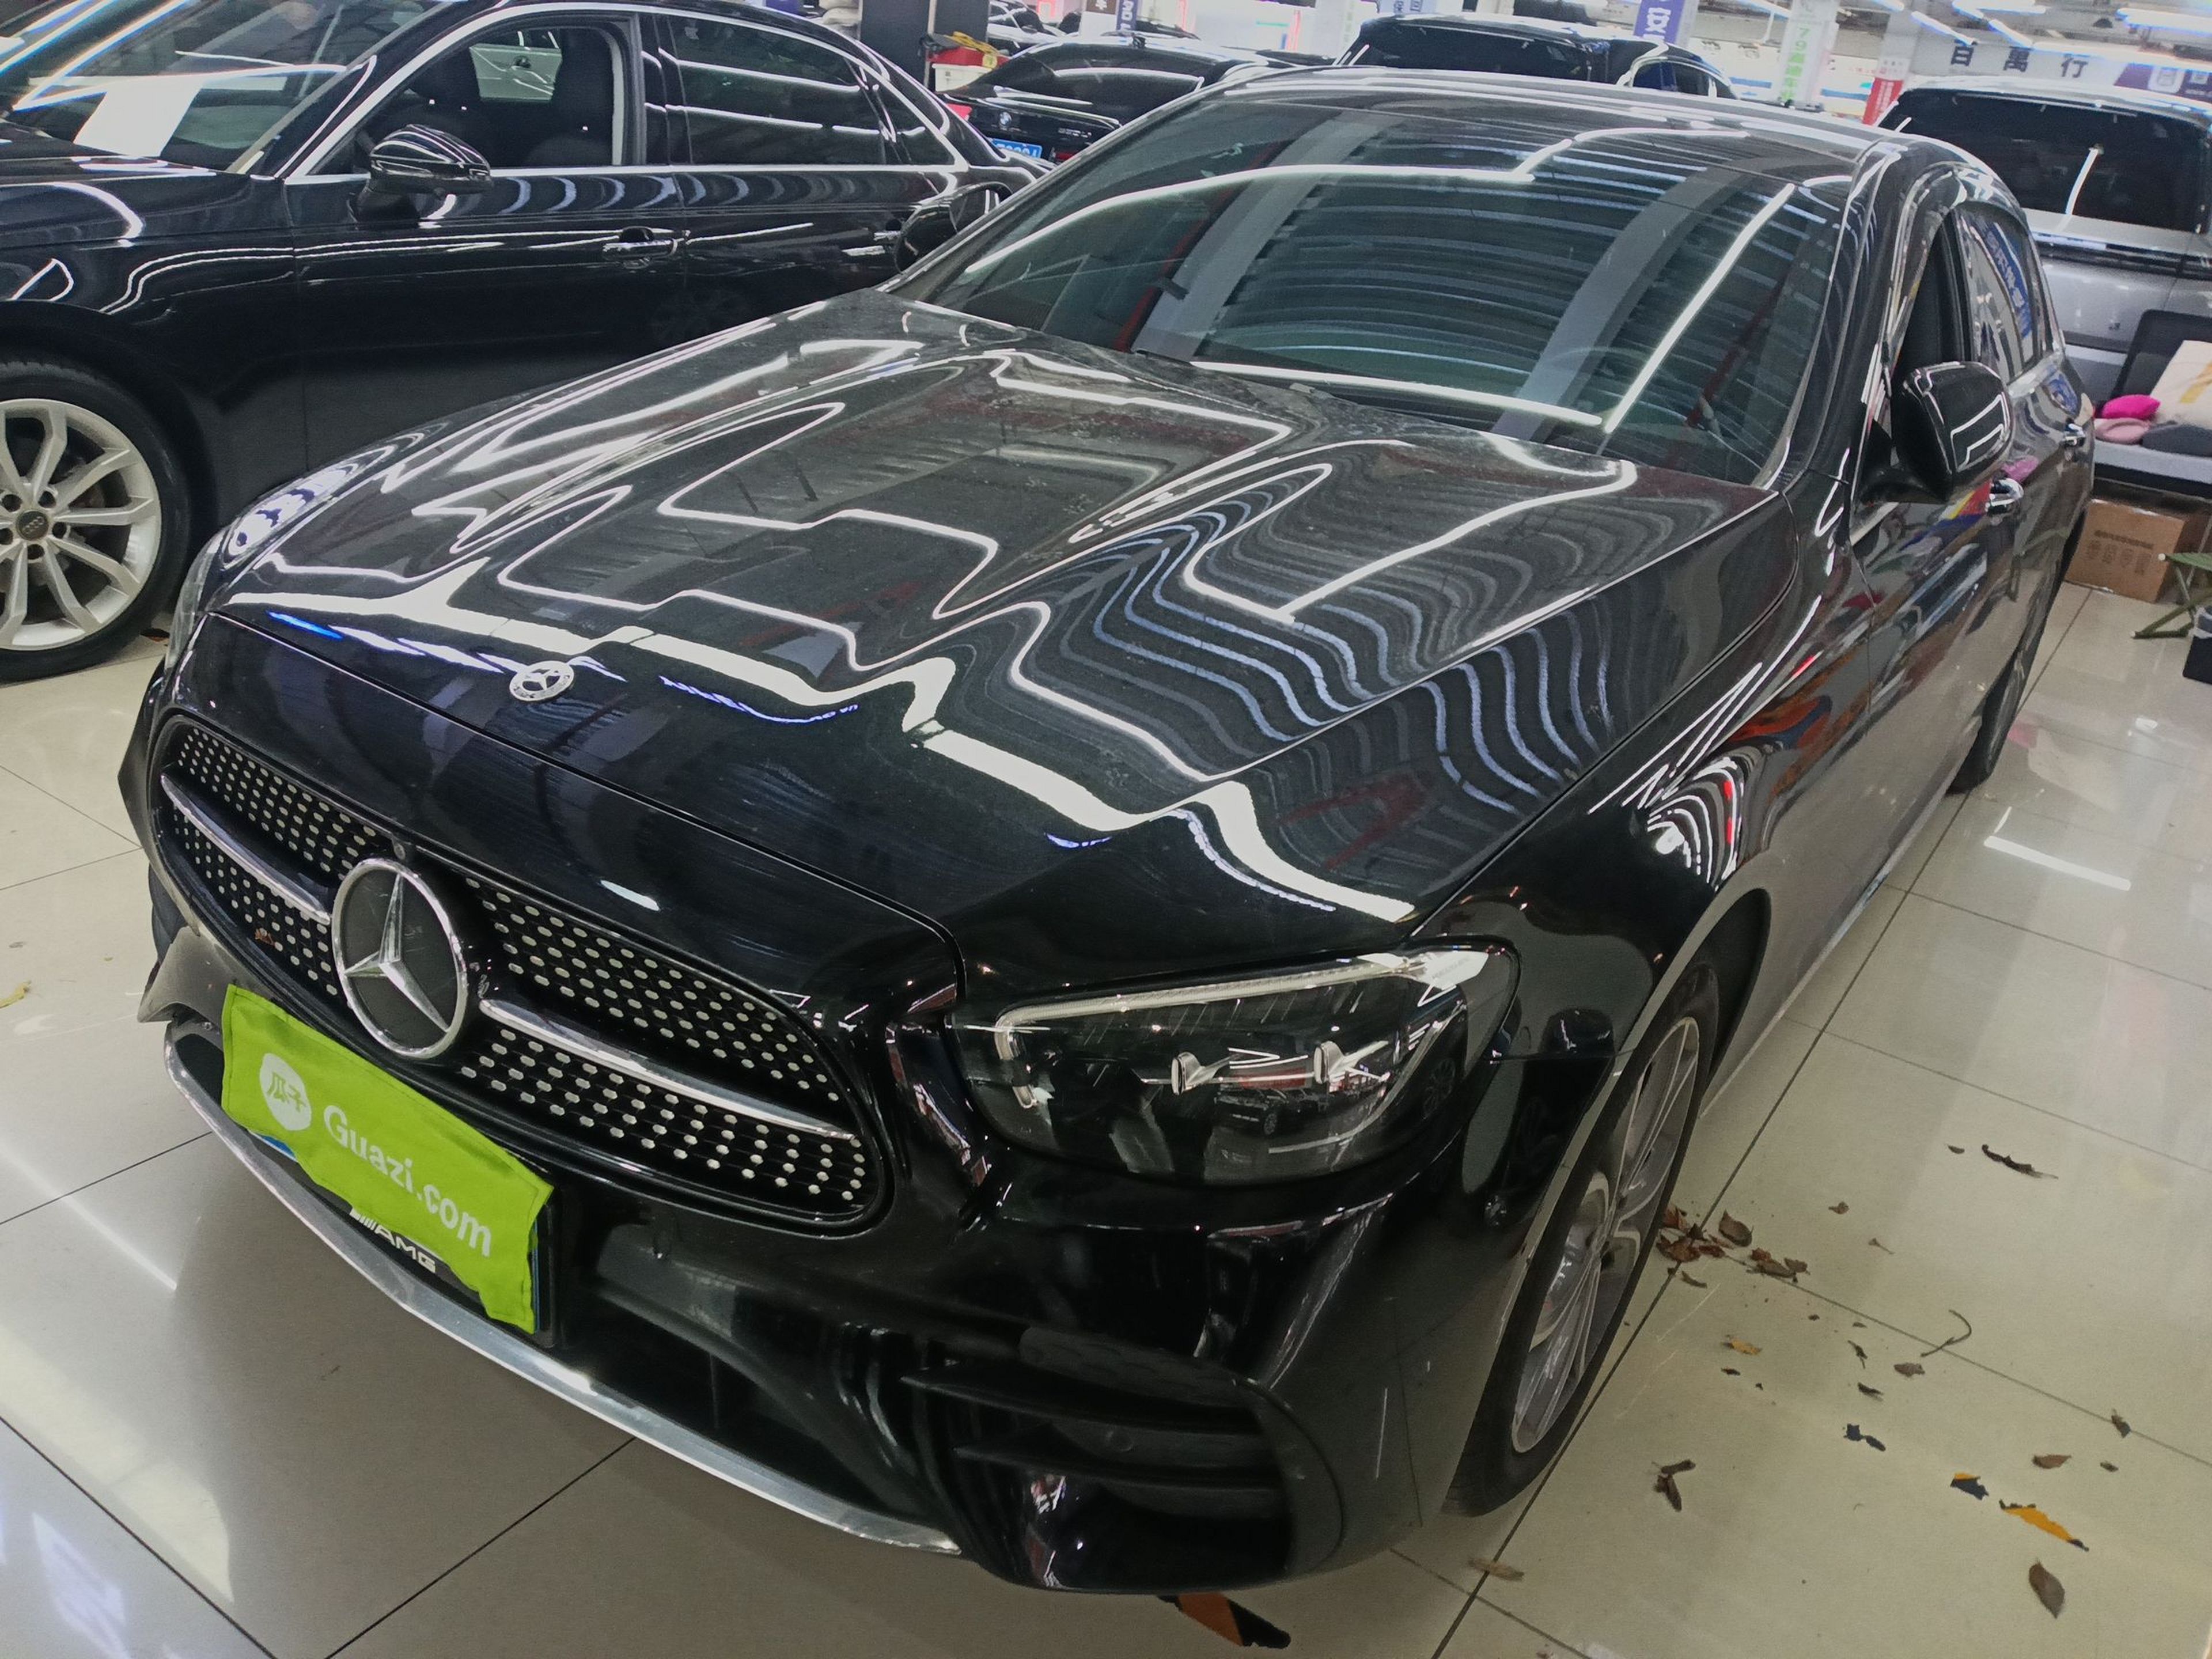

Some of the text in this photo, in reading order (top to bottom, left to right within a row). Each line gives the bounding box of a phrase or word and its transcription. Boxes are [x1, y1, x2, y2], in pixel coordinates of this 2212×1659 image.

[266, 1071, 306, 1113] 瓜子
[323, 1105, 491, 1257] Guazi.com
[373, 1224, 436, 1273] AMG
